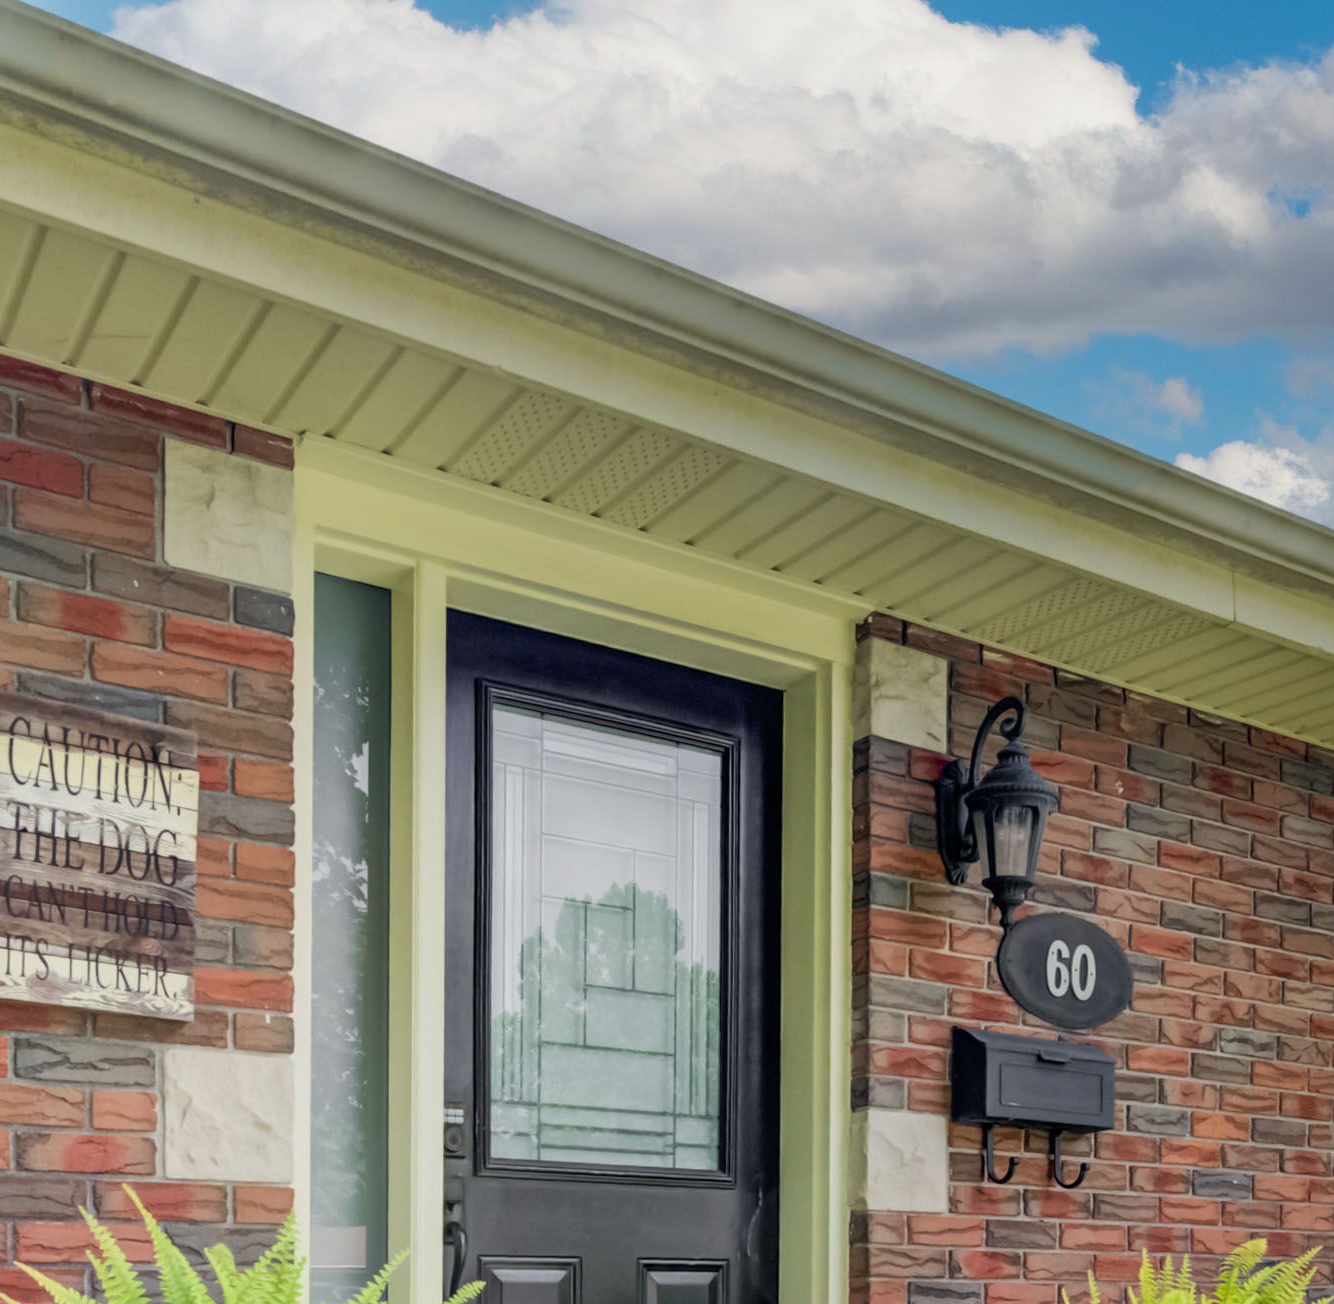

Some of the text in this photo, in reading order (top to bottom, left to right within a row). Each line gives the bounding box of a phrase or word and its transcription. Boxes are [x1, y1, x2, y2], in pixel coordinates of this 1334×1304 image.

[7, 799, 179, 887] THE DOG
[4, 874, 180, 941] CAN'T HOLD
[5, 932, 178, 999] ITS LICKER.
[1046, 939, 1097, 1001] 60
